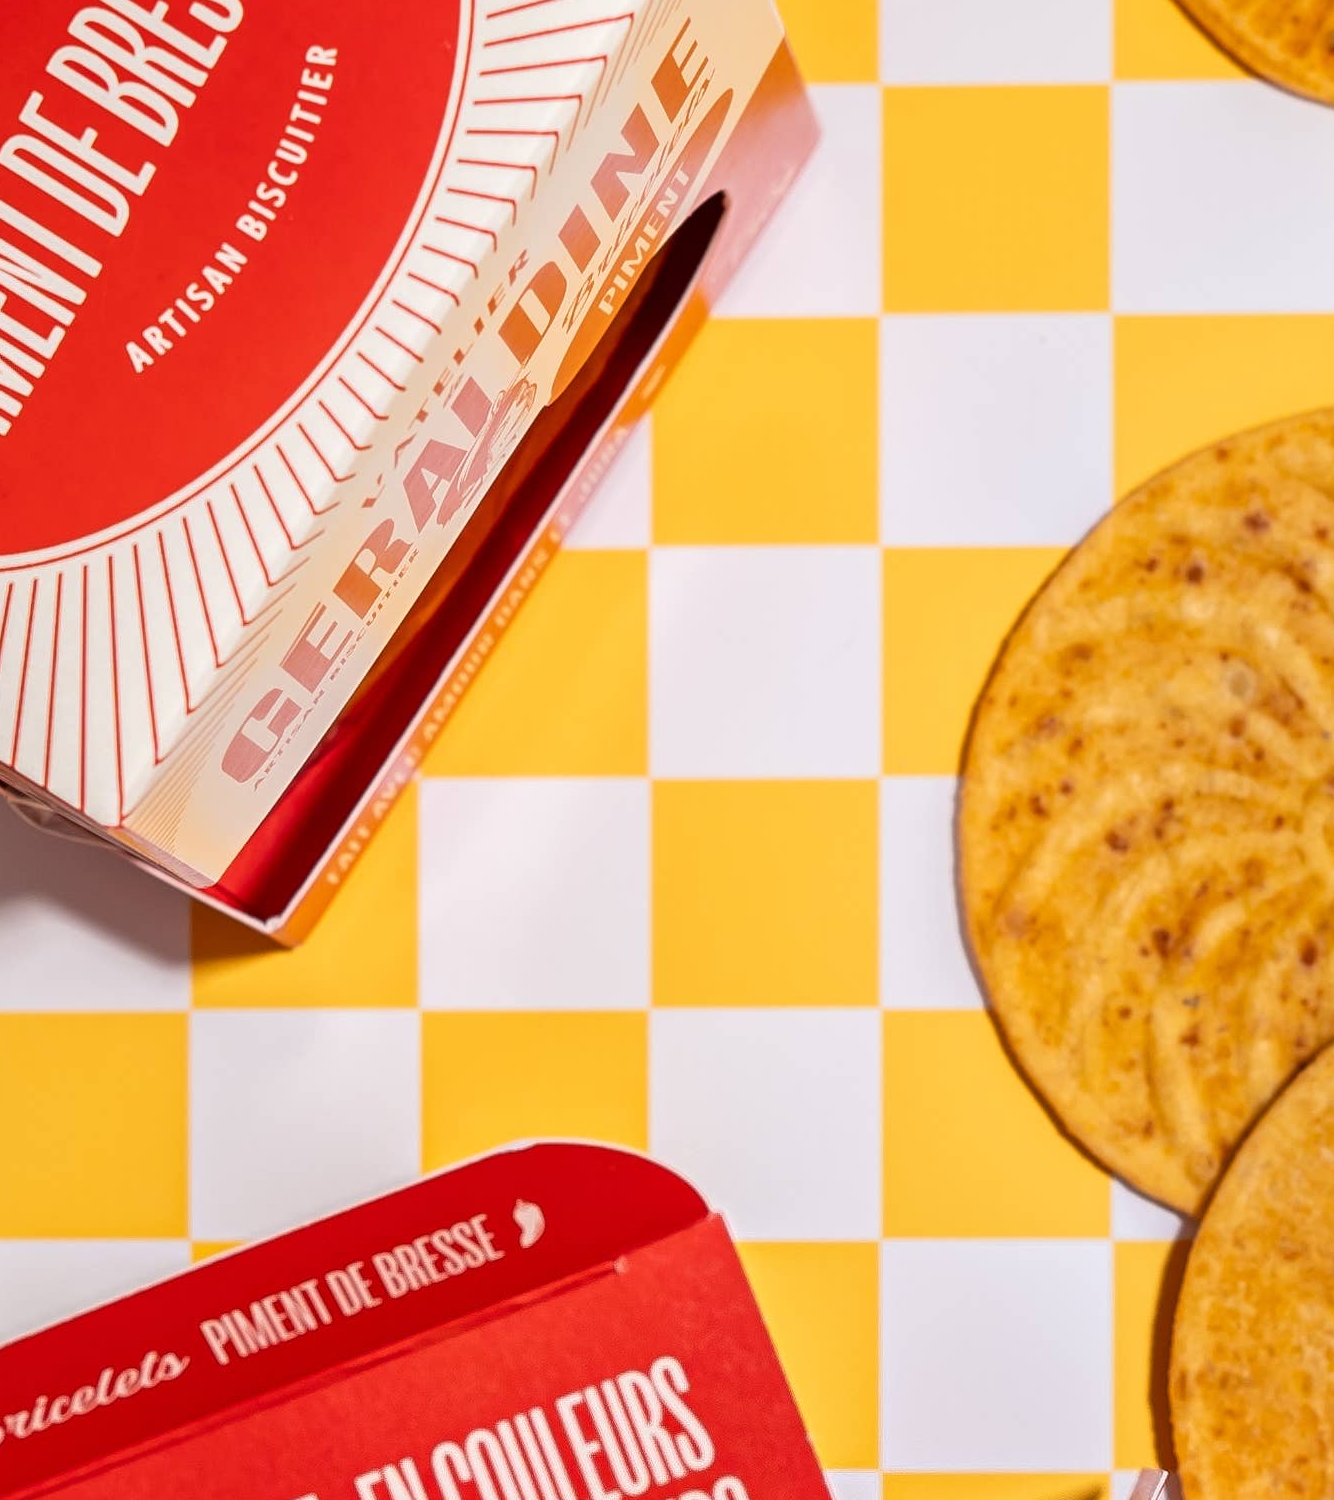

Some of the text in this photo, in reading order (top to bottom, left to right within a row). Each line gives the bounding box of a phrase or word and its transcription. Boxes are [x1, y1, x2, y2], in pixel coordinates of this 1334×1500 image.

[126, 43, 337, 373] ARTISAN BISCUITIER
[597, 162, 690, 316] PIMENT
[329, 547, 420, 681] BISCUITIER
[200, 1280, 330, 1365] PIMENT
[325, 1262, 381, 1316] DE
[373, 1214, 503, 1298] BRESSE
